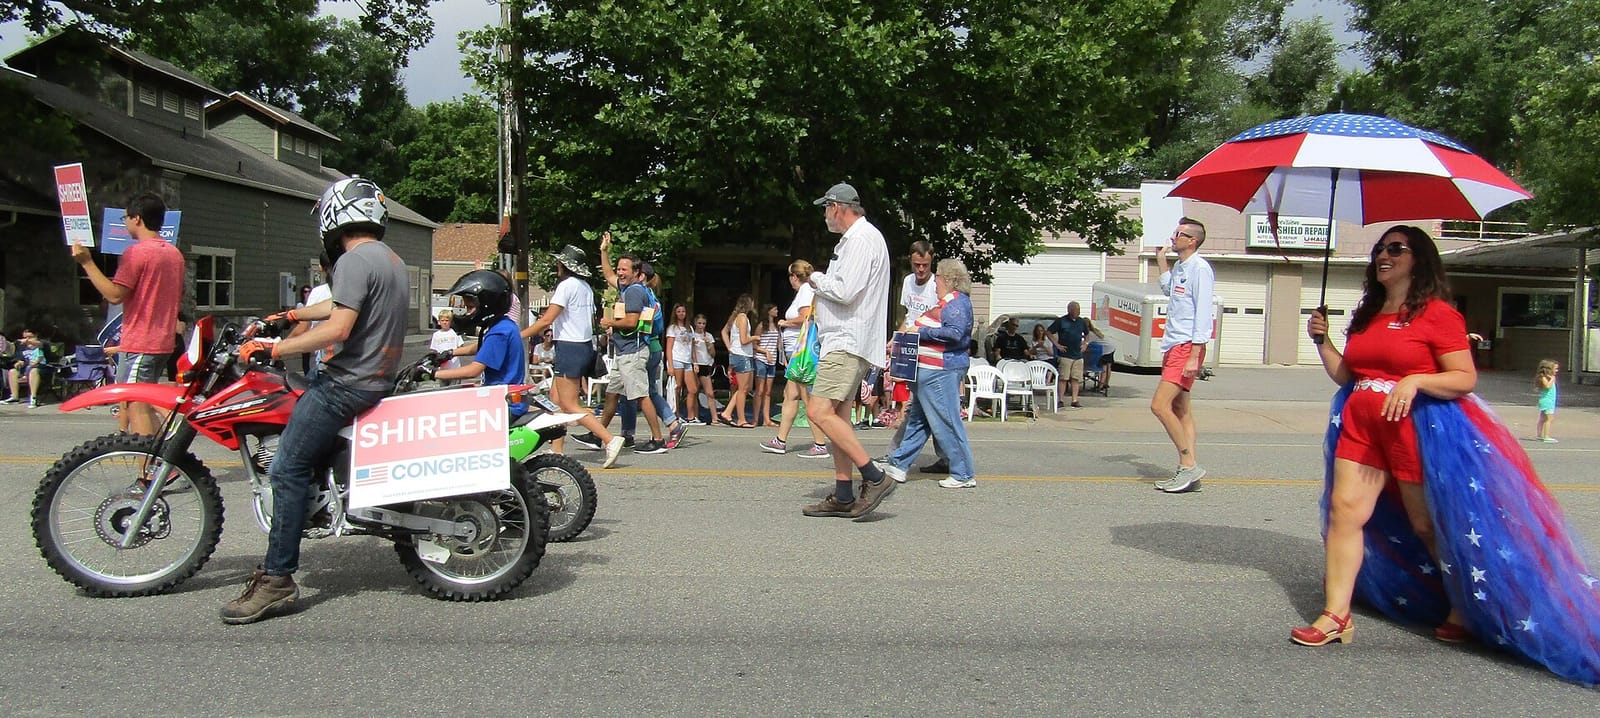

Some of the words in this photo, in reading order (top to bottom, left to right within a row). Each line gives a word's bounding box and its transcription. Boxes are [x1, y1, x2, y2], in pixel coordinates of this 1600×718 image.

[1257, 226, 1303, 235] WINSHIELD
[359, 408, 502, 448] SHIREEN
[391, 453, 504, 480] CONGRESS
